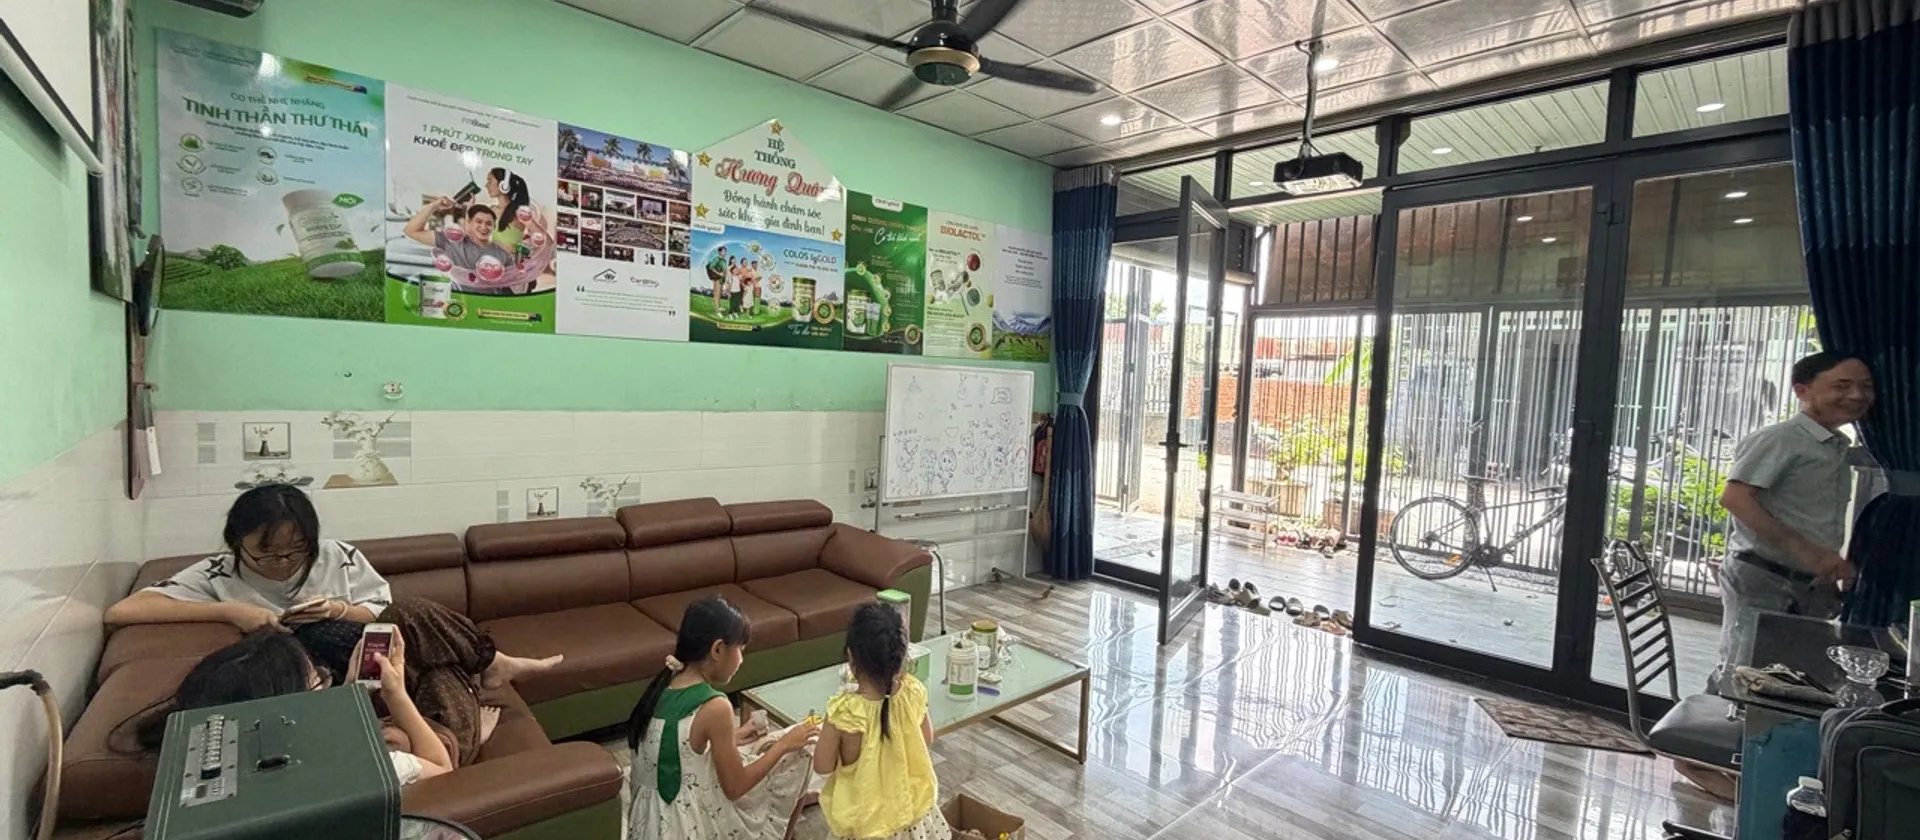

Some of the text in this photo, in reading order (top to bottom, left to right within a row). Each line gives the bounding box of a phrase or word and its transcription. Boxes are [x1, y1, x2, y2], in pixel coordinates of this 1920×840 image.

[182, 96, 230, 121] TINH
[234, 105, 286, 125] THẦN
[290, 112, 328, 127] THƯ
[329, 115, 368, 138] THÁI
[422, 124, 527, 152] 1 PHÚT XONG NGAY
[766, 137, 785, 152] HỆ
[475, 147, 513, 162] TRONG
[515, 155, 534, 166] TAY
[754, 149, 797, 169] THỐNG
[783, 249, 809, 260] COLOS
